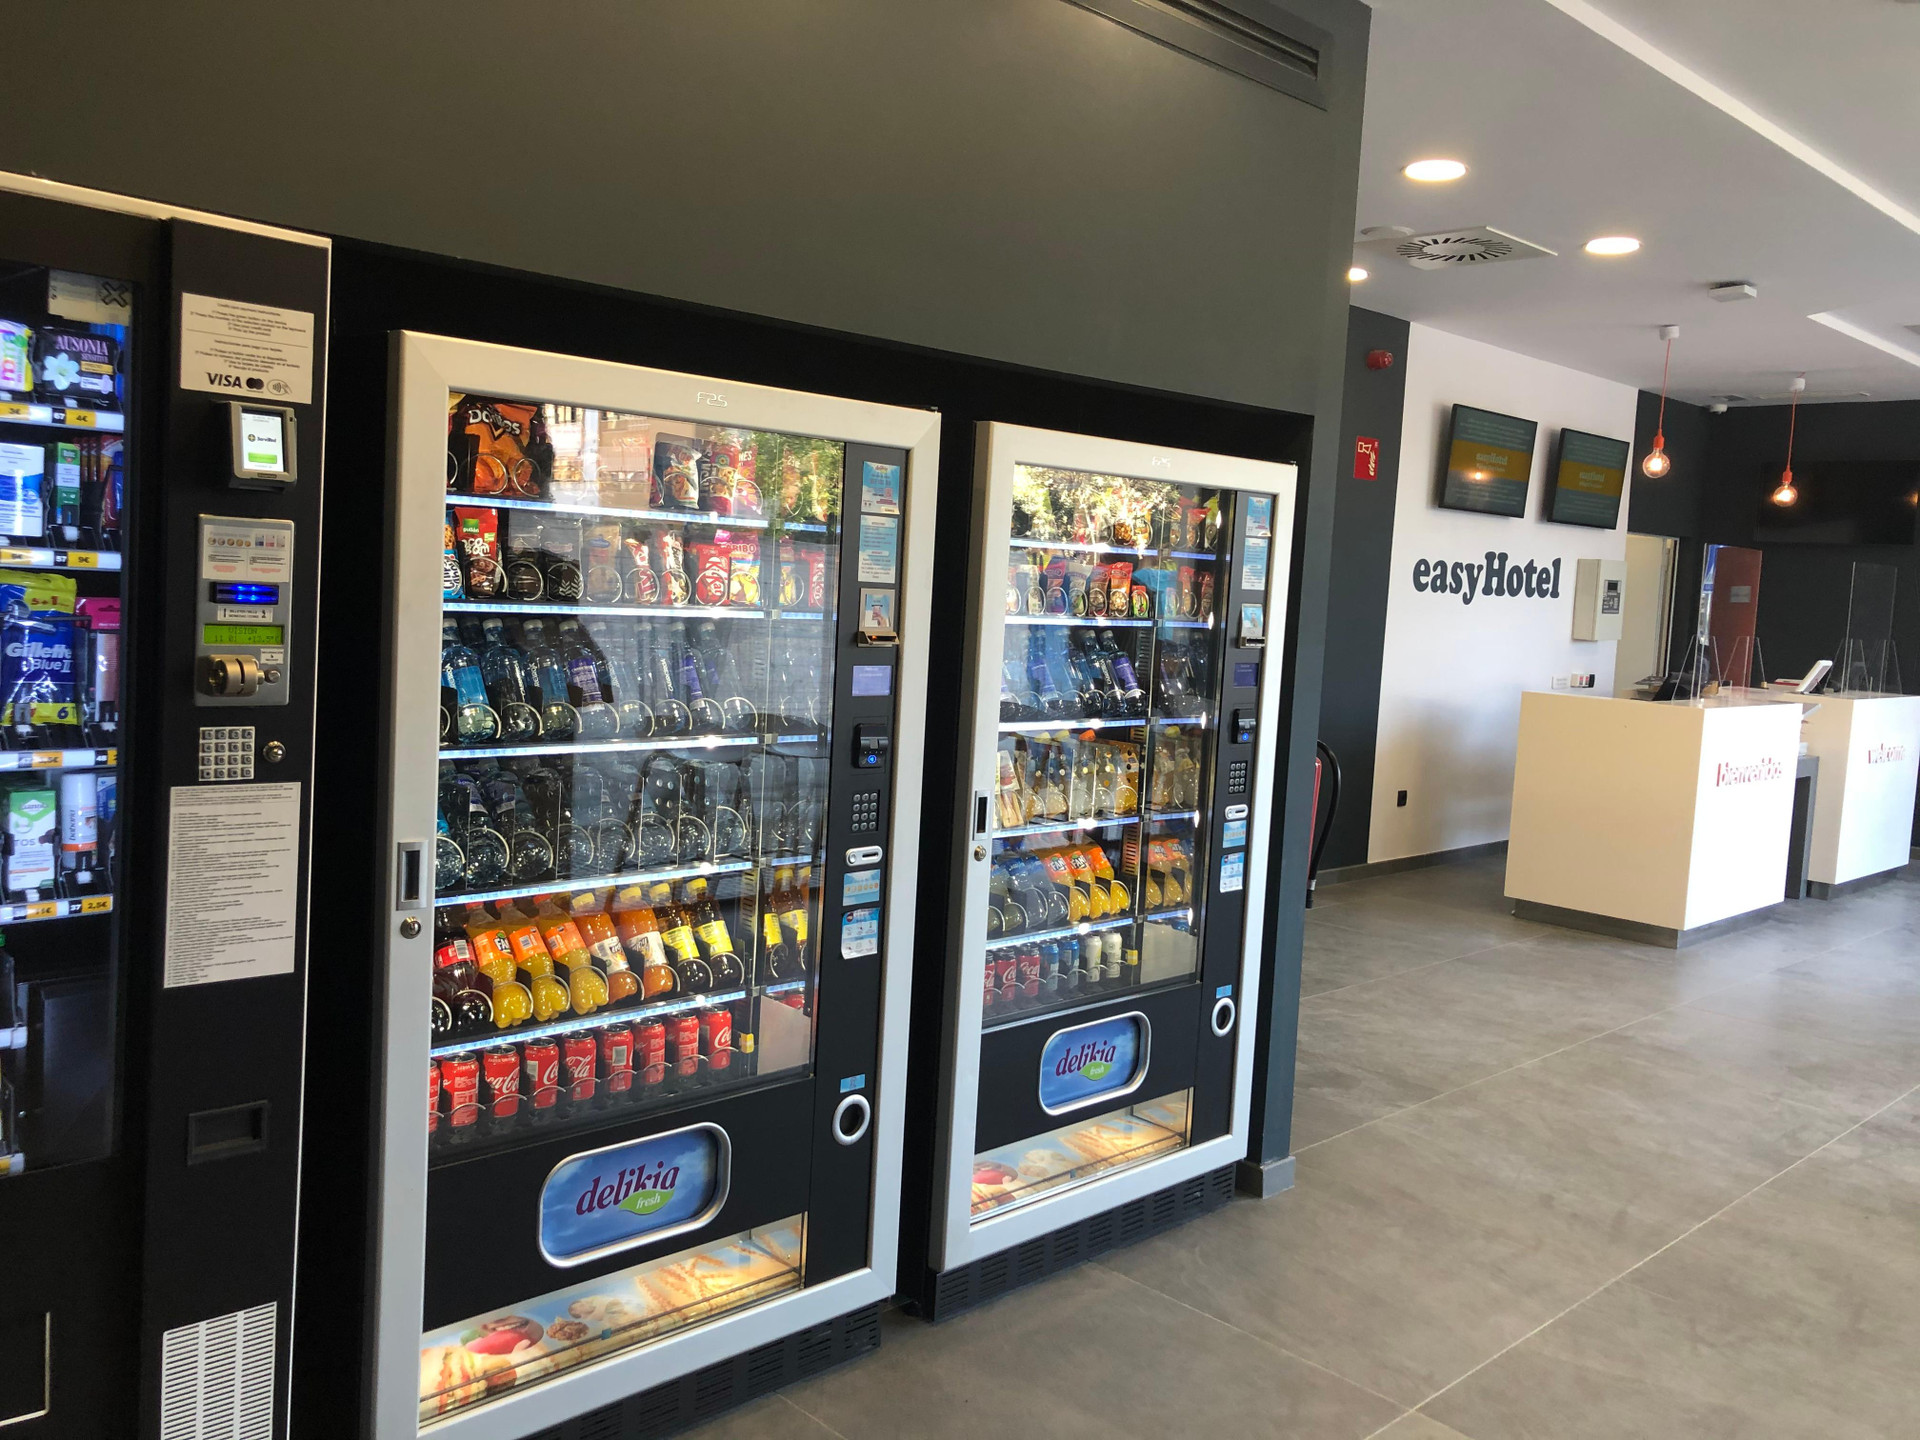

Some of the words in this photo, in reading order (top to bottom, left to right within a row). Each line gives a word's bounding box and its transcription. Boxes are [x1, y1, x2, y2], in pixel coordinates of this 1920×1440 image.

[55, 334, 109, 356] AUSONIA
[206, 371, 243, 389] VISA
[1412, 551, 1562, 605] easyHotel
[228, 626, 258, 635] VISION
[6, 641, 72, 659] Gillette
[31, 658, 62, 672] Blue
[1055, 1040, 1117, 1077] delikia
[1089, 1064, 1105, 1075] fresh
[576, 1160, 681, 1216] delikia
[635, 1191, 662, 1210] fresh
